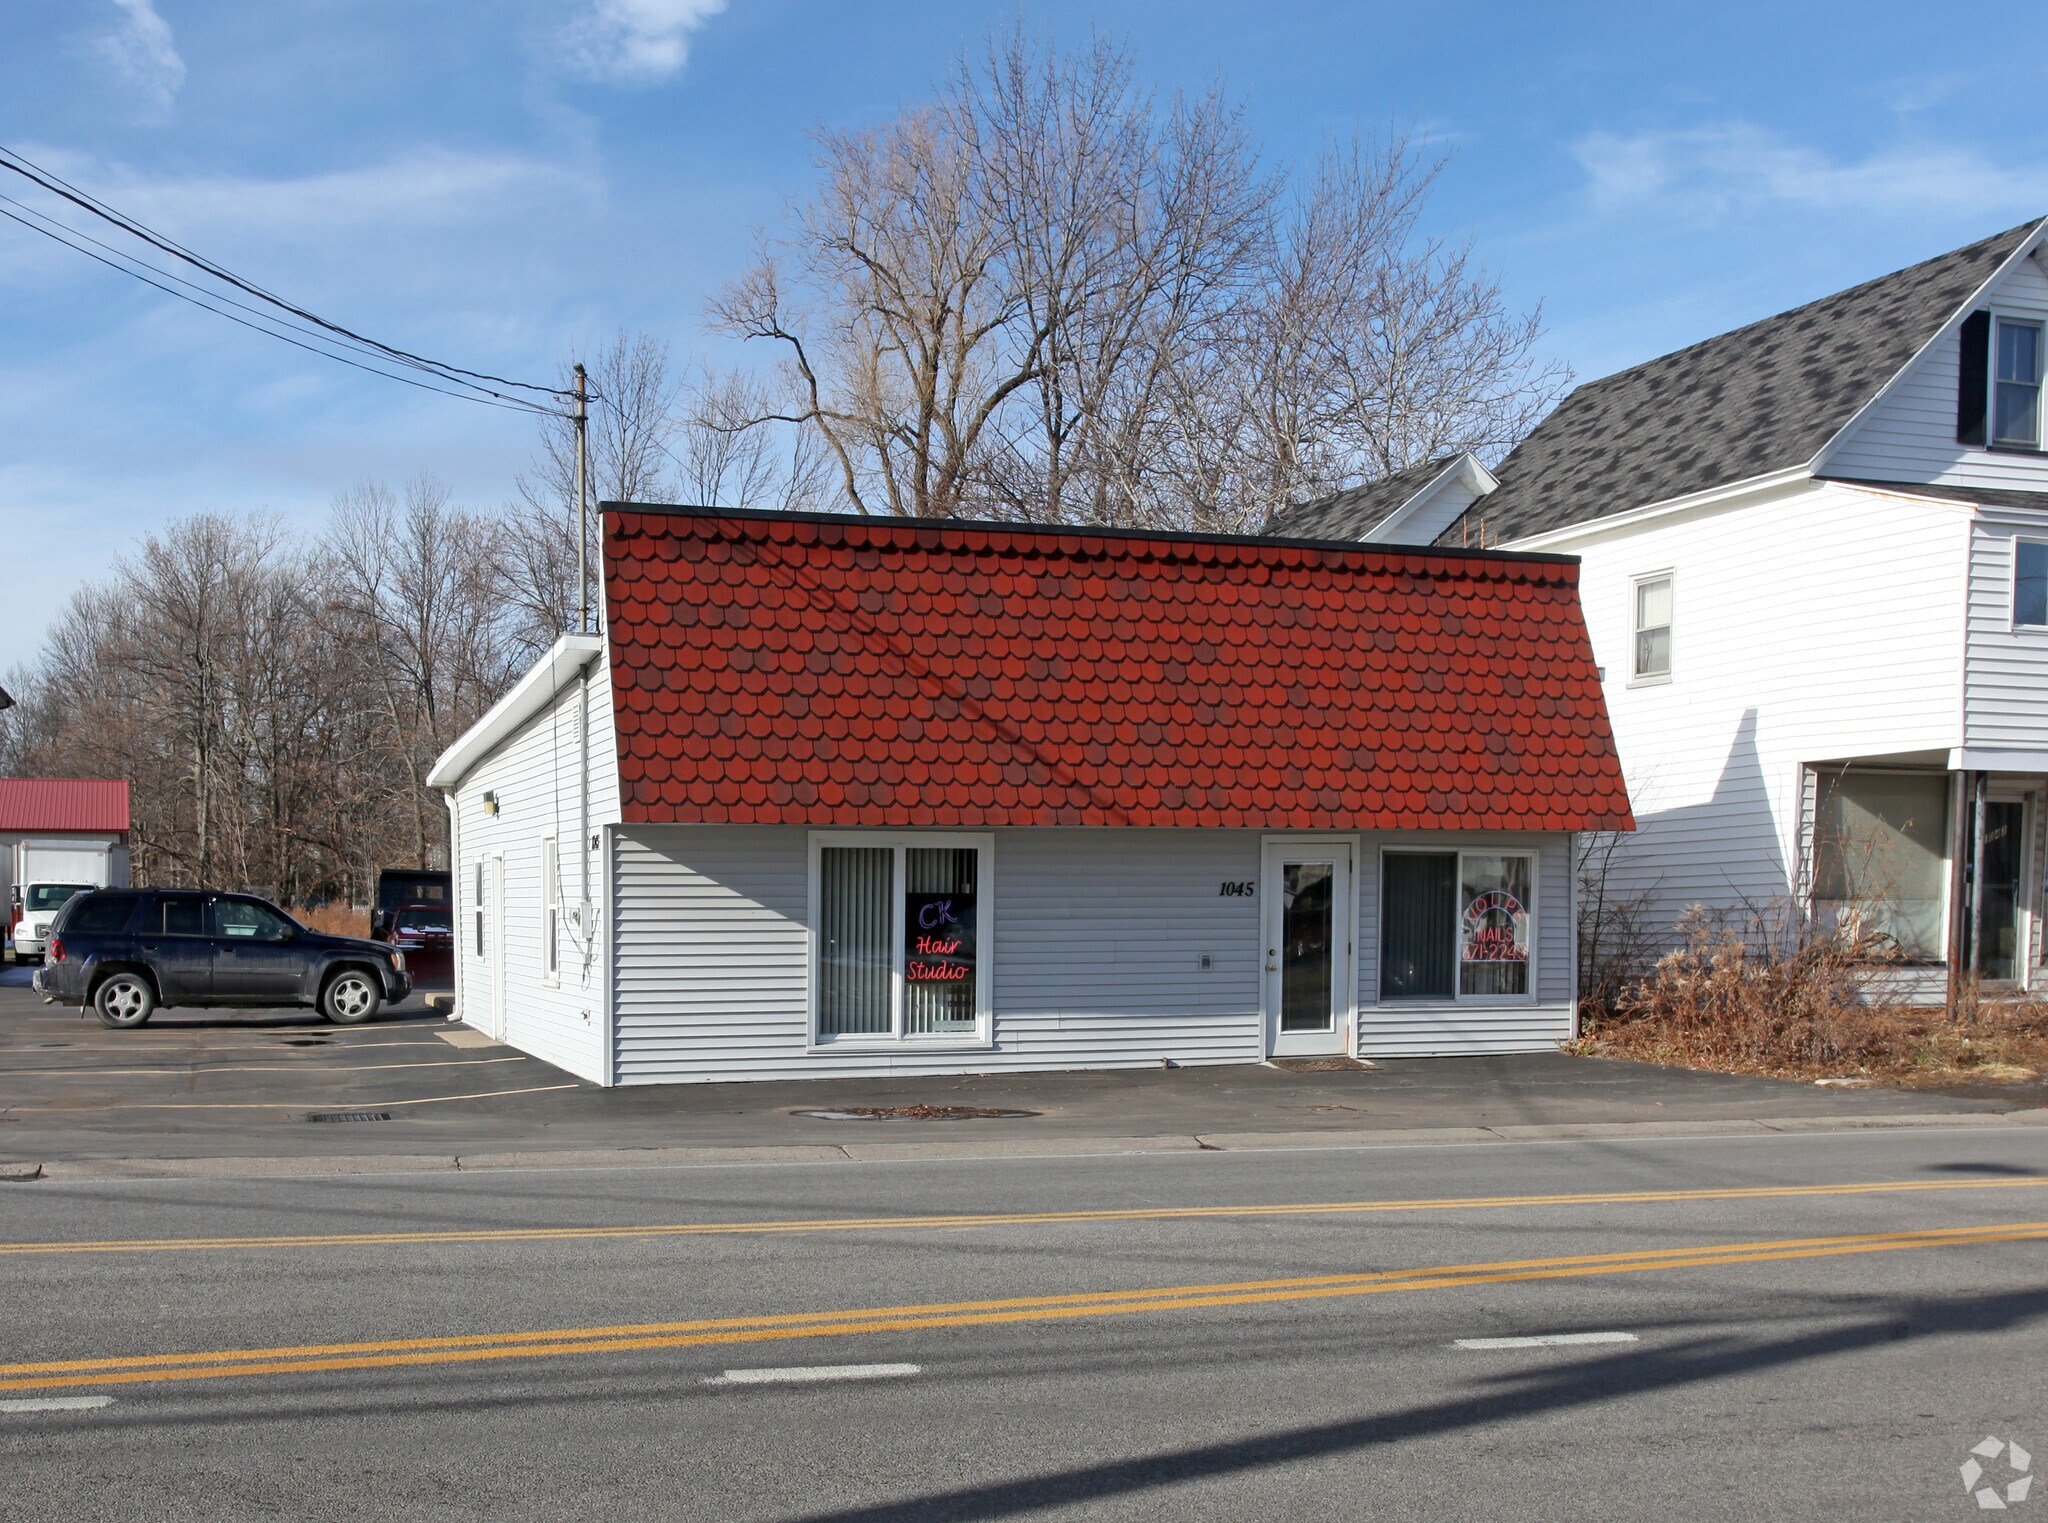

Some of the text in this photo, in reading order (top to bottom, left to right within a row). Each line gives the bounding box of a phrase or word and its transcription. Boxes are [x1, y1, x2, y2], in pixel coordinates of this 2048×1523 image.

[1219, 881, 1255, 897] 1045
[919, 900, 958, 929] CK
[1476, 927, 1513, 942] NAILS
[916, 936, 962, 955] Hair
[907, 960, 970, 980] Studio
